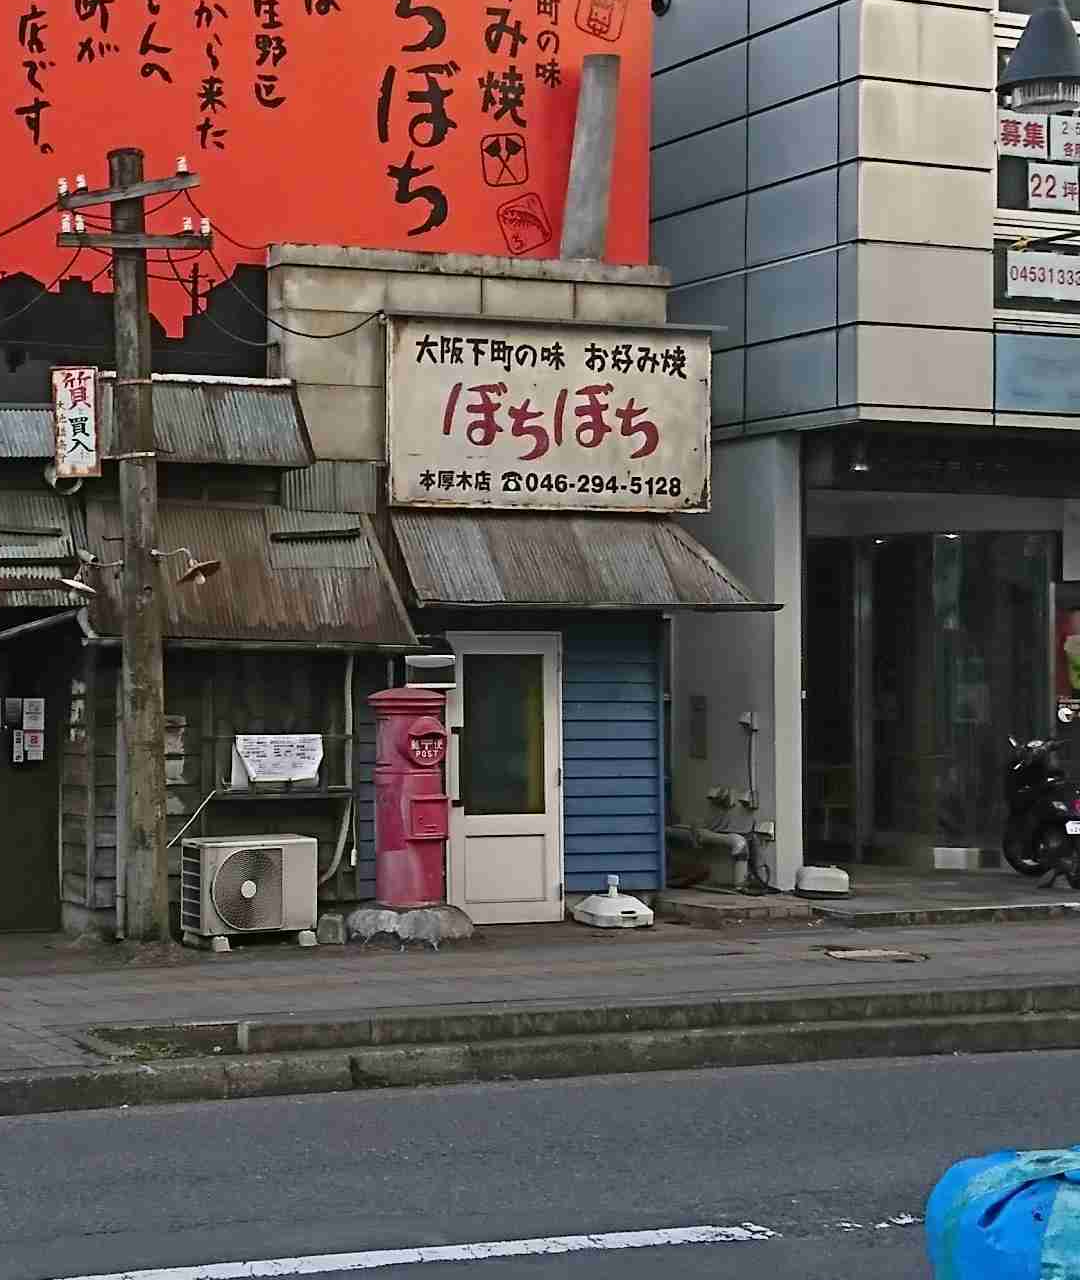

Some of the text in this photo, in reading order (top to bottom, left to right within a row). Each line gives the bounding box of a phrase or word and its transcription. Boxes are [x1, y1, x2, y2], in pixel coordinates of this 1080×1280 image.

[1001, 119, 1045, 149] 募集
[415, 334, 688, 380] 大阪下町の味 お好み焼
[442, 381, 660, 461] ぼちぼち
[419, 470, 682, 498] 本厚木店 046-294-5128
[415, 750, 439, 759] POST
